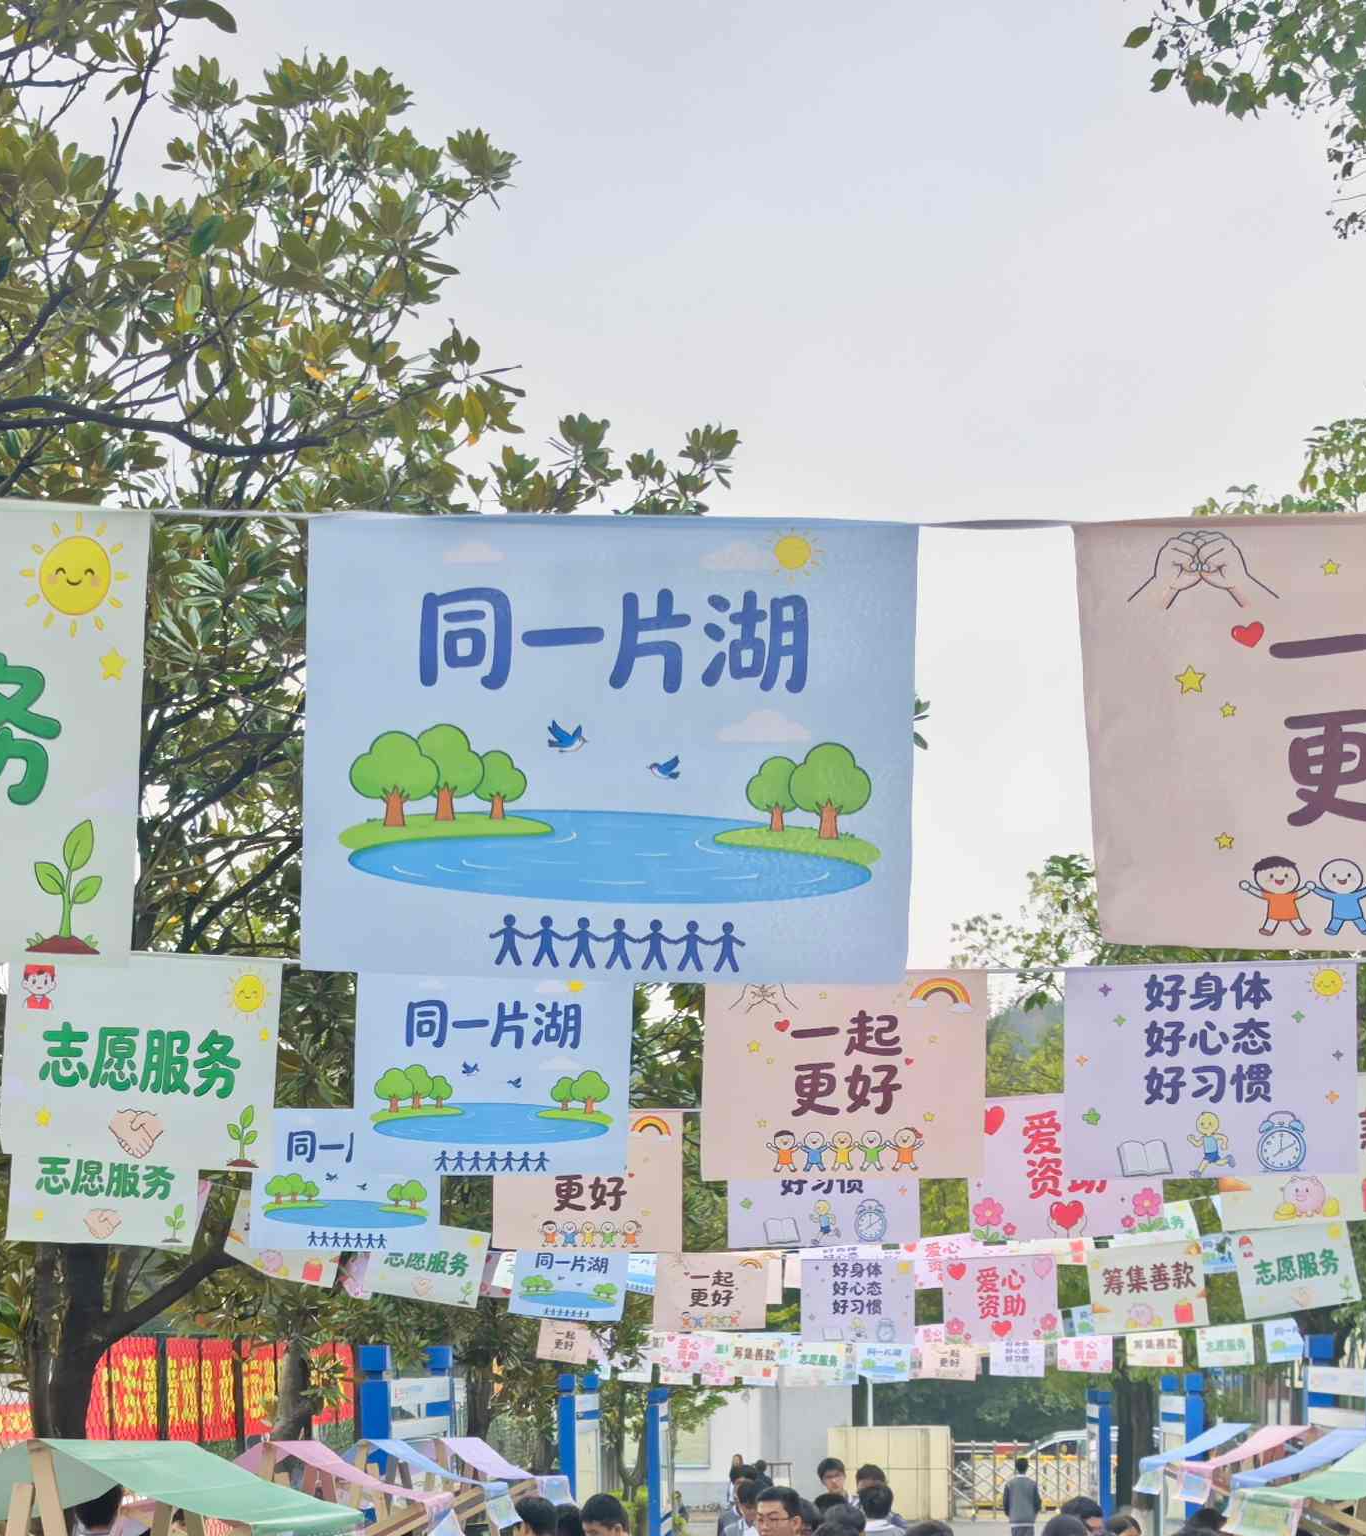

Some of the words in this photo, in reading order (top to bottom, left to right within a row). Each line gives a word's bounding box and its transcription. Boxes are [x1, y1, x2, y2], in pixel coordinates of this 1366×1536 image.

[419, 587, 809, 694] 同一片湖
[1144, 971, 1273, 1012] 好身体
[405, 1000, 582, 1050] 同一片湖
[790, 1009, 903, 1057] 一起
[1144, 1017, 1273, 1058] 好心态
[38, 1021, 241, 1100] 志愿服务
[790, 1062, 903, 1118] 更好
[1144, 1063, 1273, 1105] 好习惯
[1022, 1109, 1062, 1156] 爱
[36, 1155, 176, 1200] 志愿服务
[554, 1174, 629, 1213] 更好
[535, 1251, 610, 1275] 同一片湖
[690, 1269, 735, 1288] 一起
[832, 1262, 883, 1278] 好身体
[976, 1266, 1026, 1294] 爱心
[1102, 1261, 1198, 1298] 筹集善款
[1252, 1249, 1341, 1288] 志愿服务
[689, 1288, 734, 1308] 更好
[832, 1281, 883, 1296] 好心态
[832, 1299, 883, 1315] 好习惯
[977, 1293, 1027, 1320] 资助
